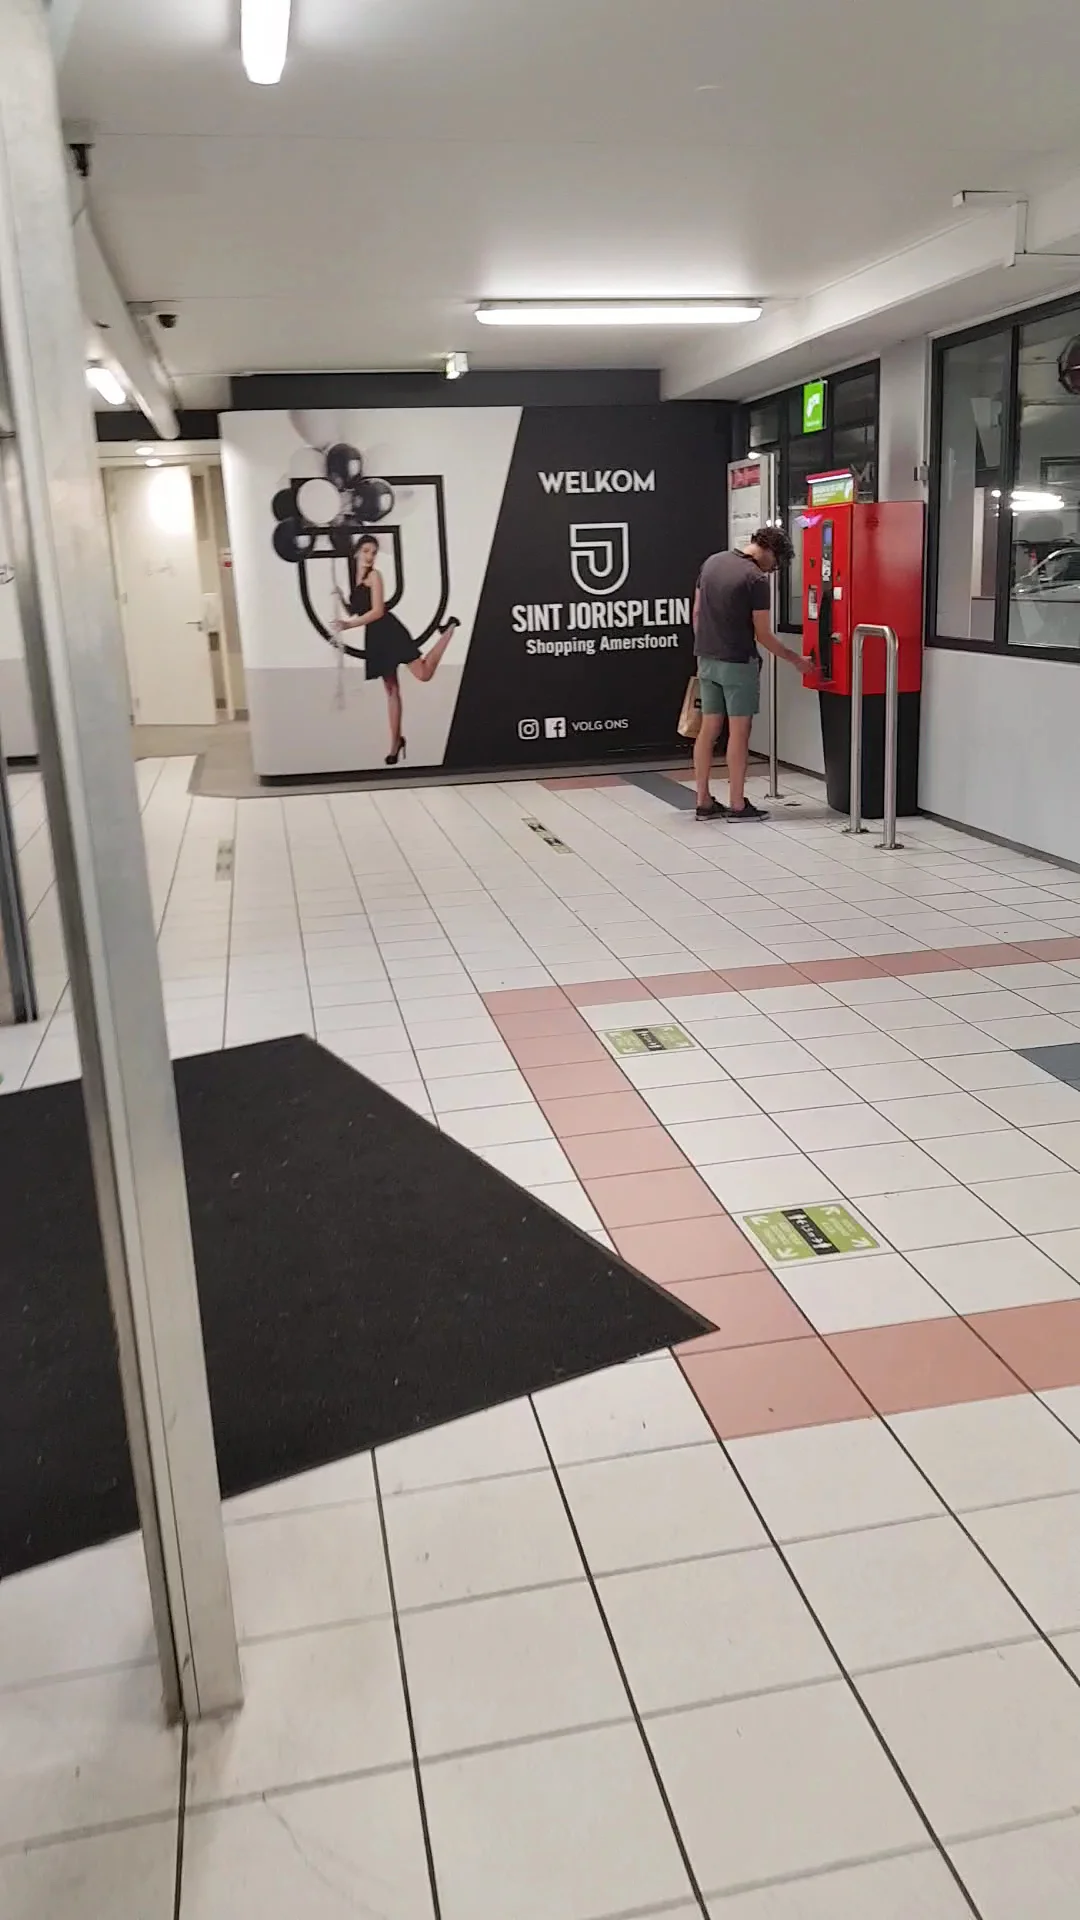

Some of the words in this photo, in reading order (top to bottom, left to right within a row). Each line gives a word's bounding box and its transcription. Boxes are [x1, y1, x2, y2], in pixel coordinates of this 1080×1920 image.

[538, 469, 656, 494] WELKOM
[511, 603, 563, 633] SINT
[566, 597, 691, 631] JORISPLEIN
[525, 637, 596, 657] Shopping
[599, 633, 679, 651] Amersfoort
[571, 720, 603, 731] VOLG
[604, 718, 629, 730] ONS
